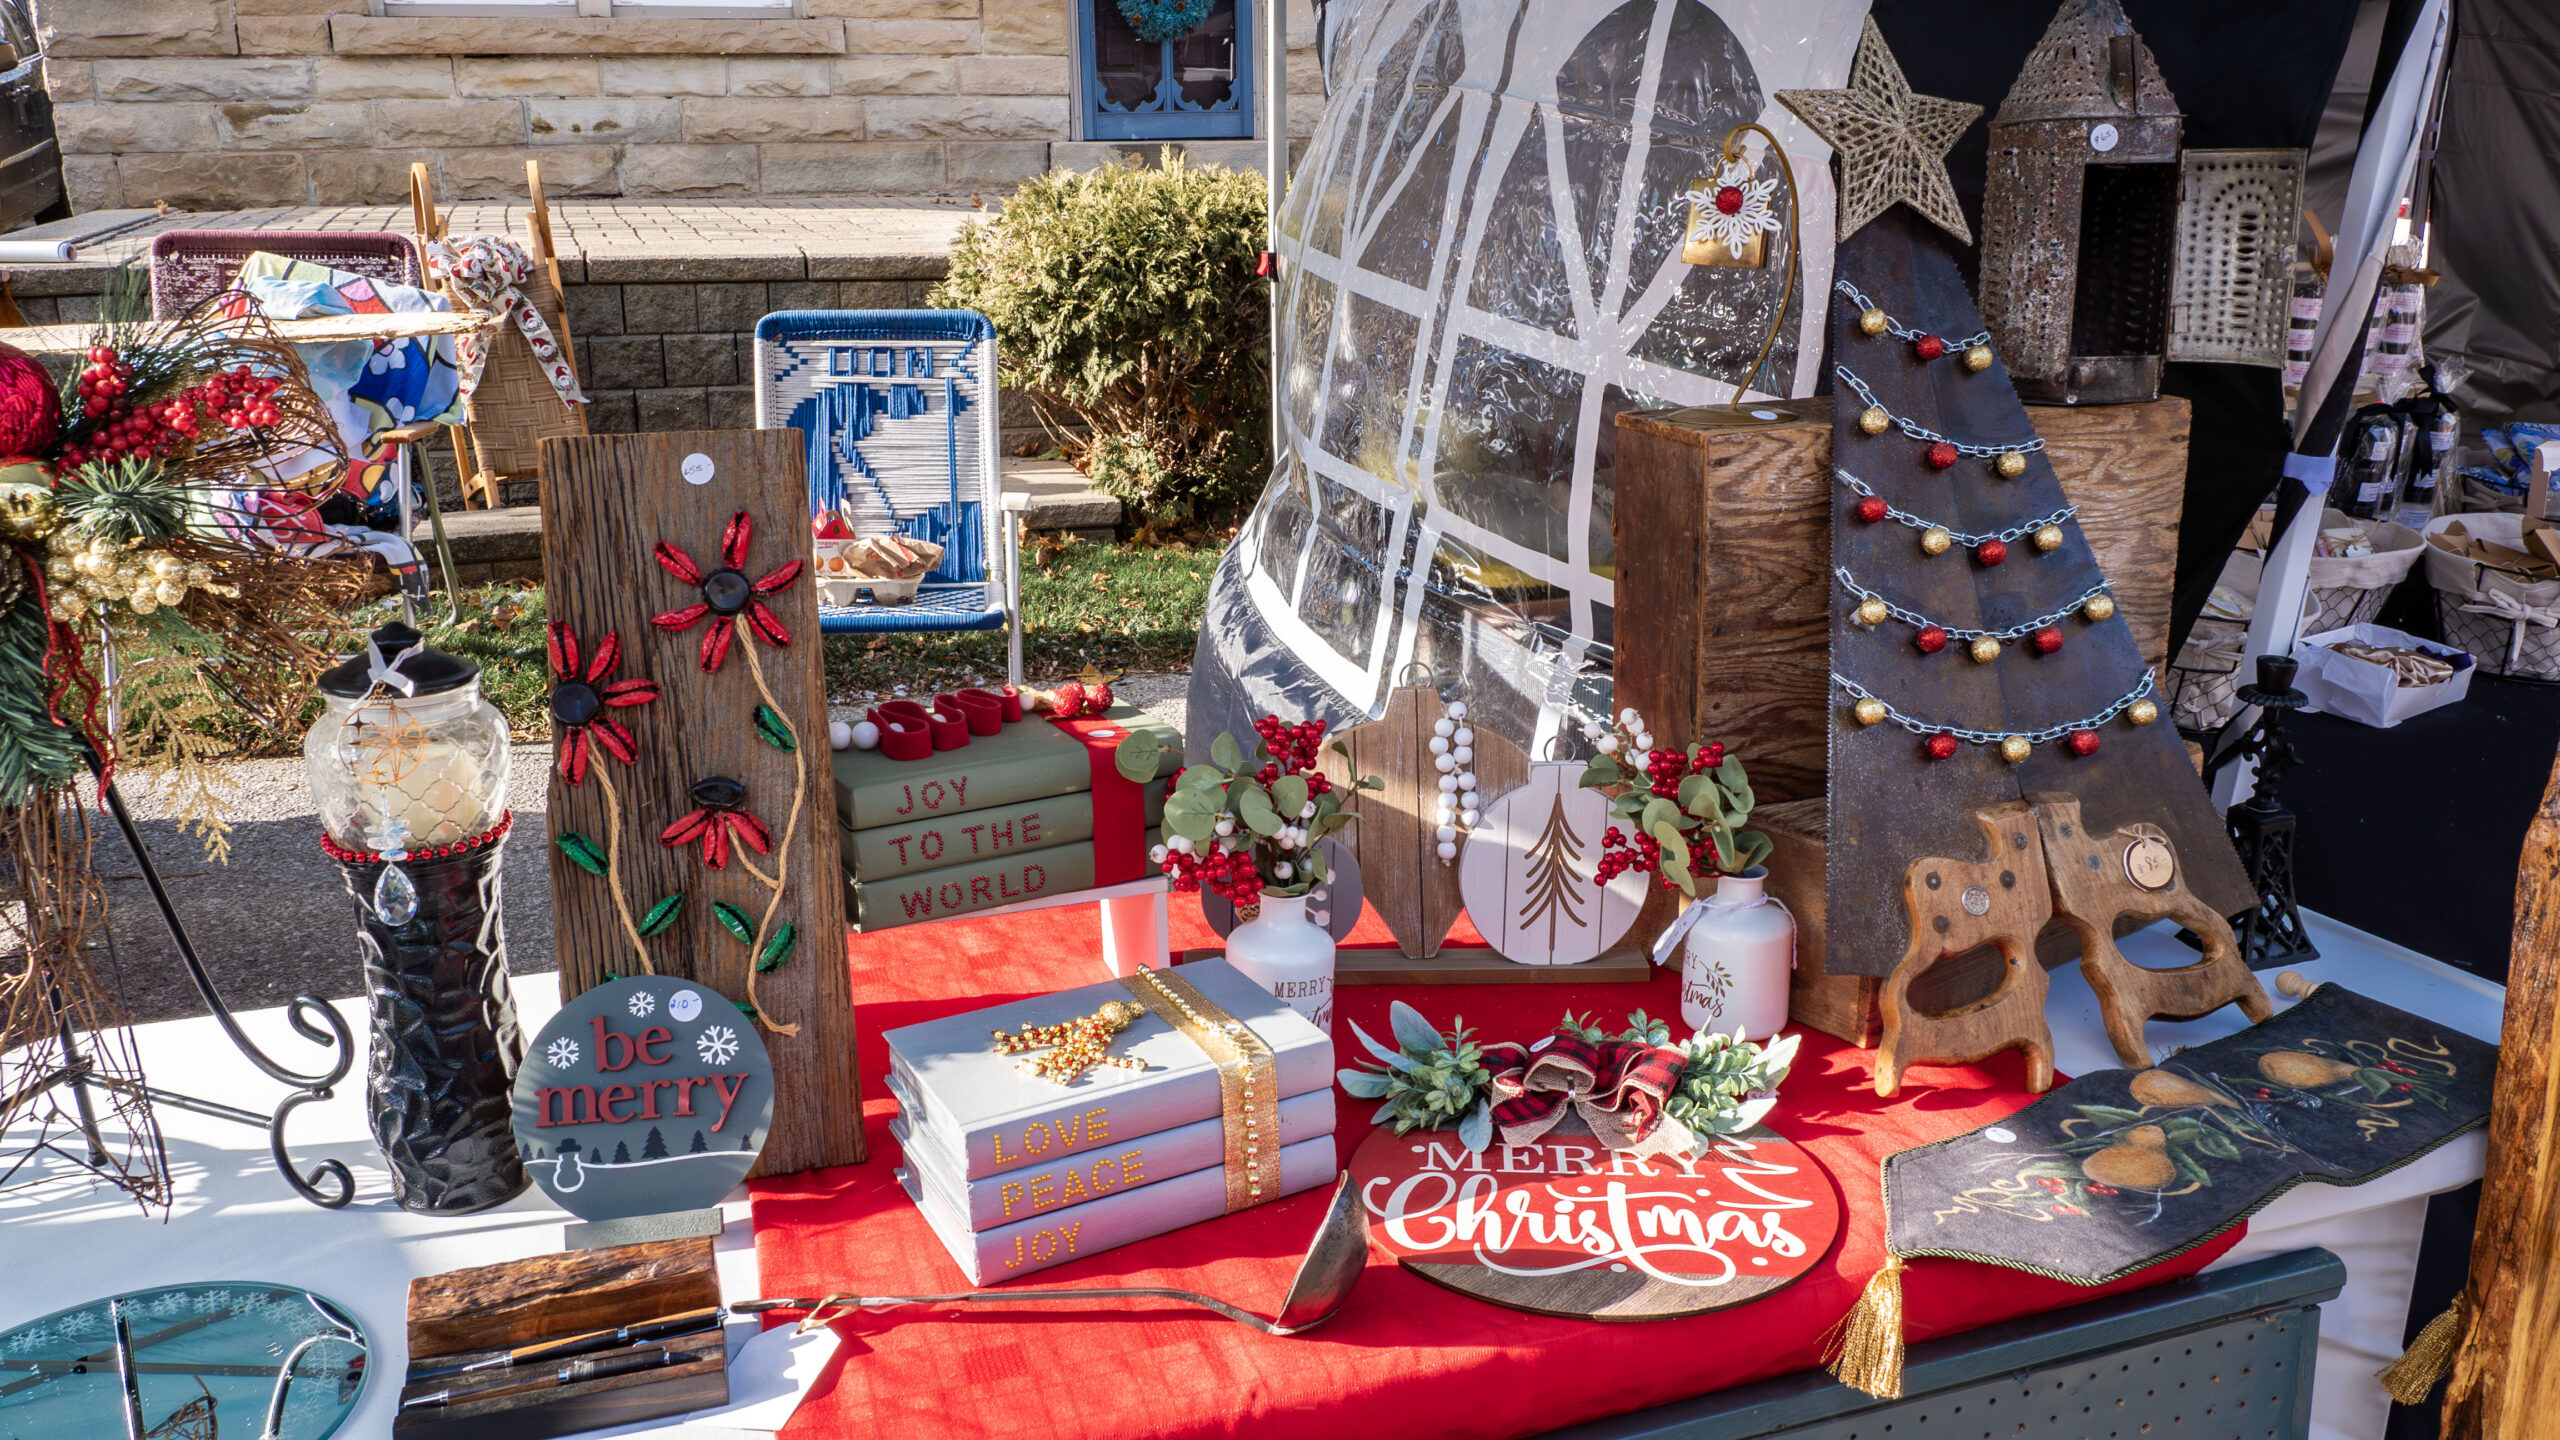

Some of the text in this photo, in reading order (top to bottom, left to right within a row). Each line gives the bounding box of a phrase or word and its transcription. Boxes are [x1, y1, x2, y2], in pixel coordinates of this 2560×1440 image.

[897, 775, 967, 815] JOY
[888, 813, 1041, 866] TO THE
[900, 864, 1046, 919] WORLD
[1274, 975, 1327, 999] MERRY
[588, 1014, 673, 1073] be
[533, 1073, 749, 1133] merry
[993, 1107, 1109, 1164] LOVE
[1001, 1149, 1146, 1217] PEACE
[1005, 1222, 1081, 1269] JOY
[1364, 1173, 1807, 1287] Christmas
